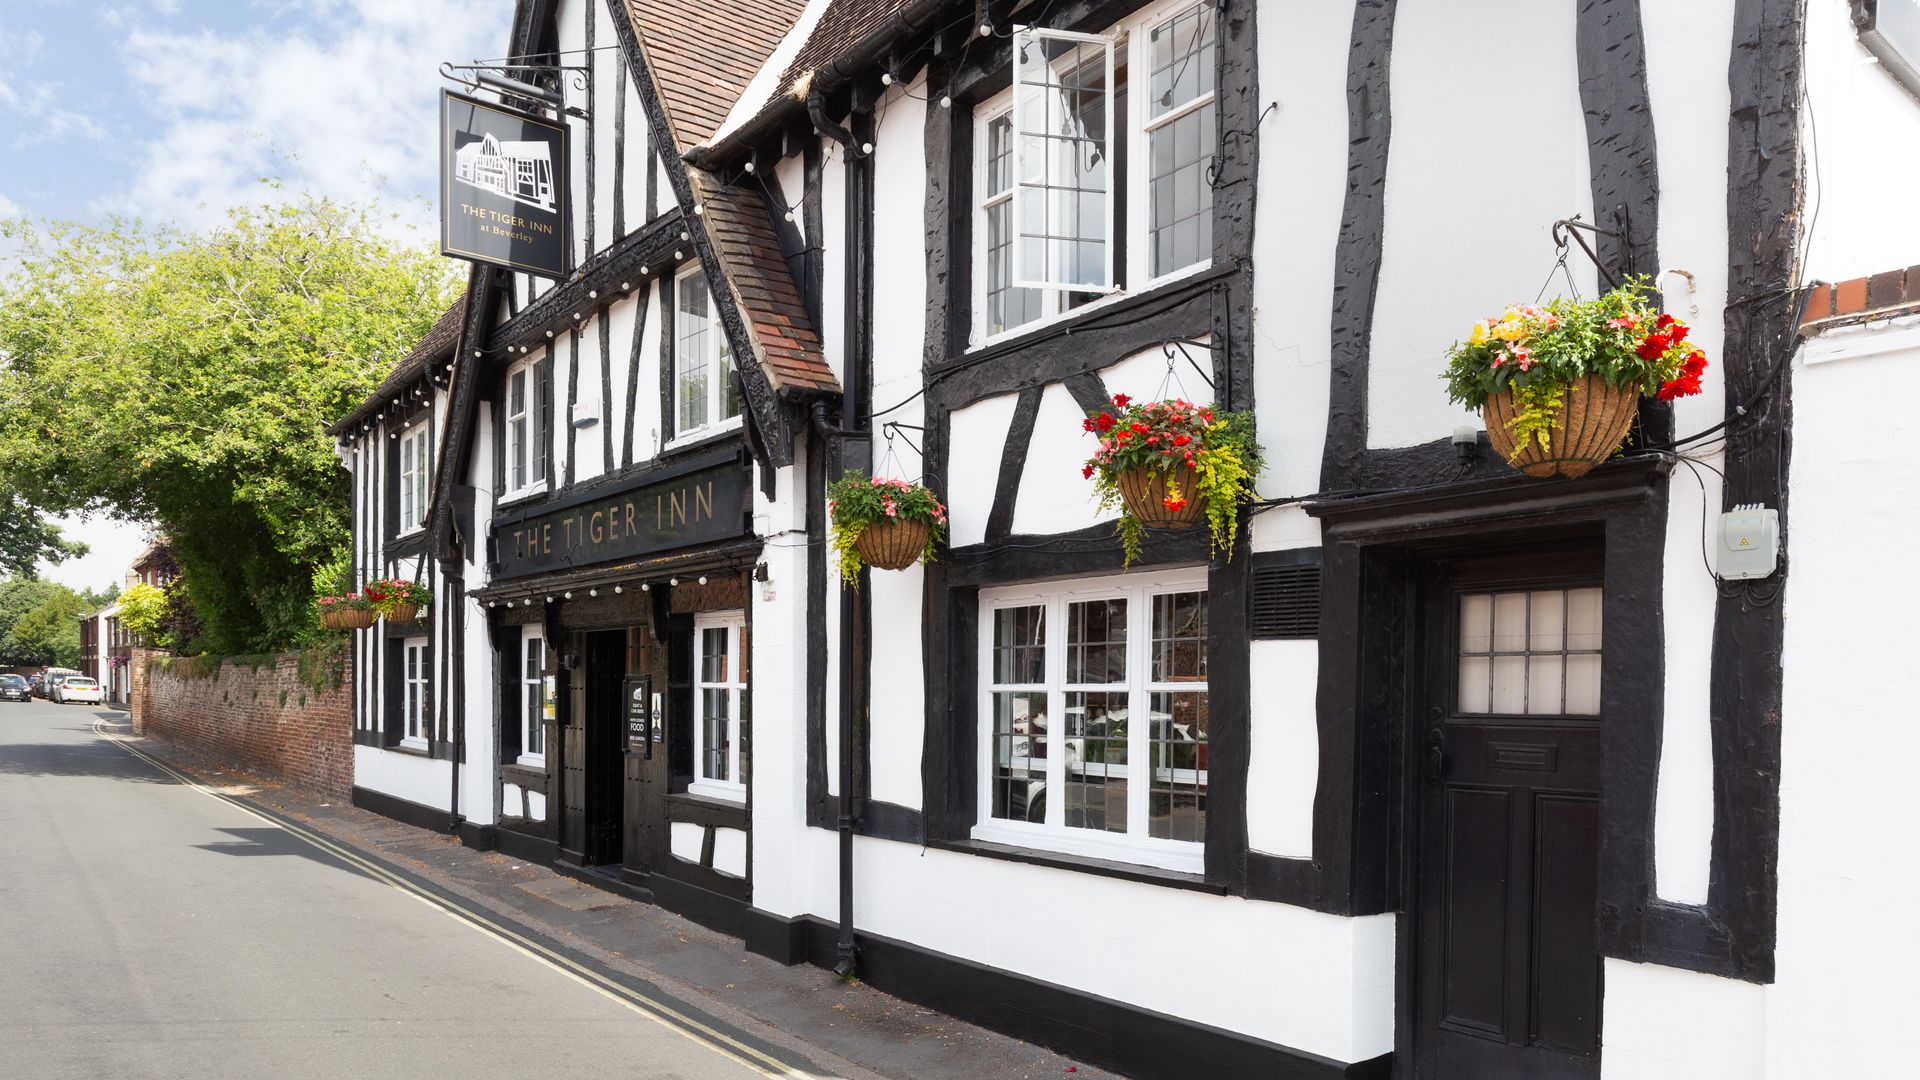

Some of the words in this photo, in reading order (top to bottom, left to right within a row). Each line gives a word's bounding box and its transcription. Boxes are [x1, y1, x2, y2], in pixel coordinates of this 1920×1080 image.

[461, 204, 486, 218] THE
[490, 210, 525, 227] TIGER
[530, 221, 552, 234] INN
[480, 224, 489, 232] at
[493, 225, 534, 243] Beverley
[514, 523, 551, 559] THE
[563, 503, 637, 548] TIGER
[657, 481, 713, 530] INN
[630, 723, 644, 731] FOOD
